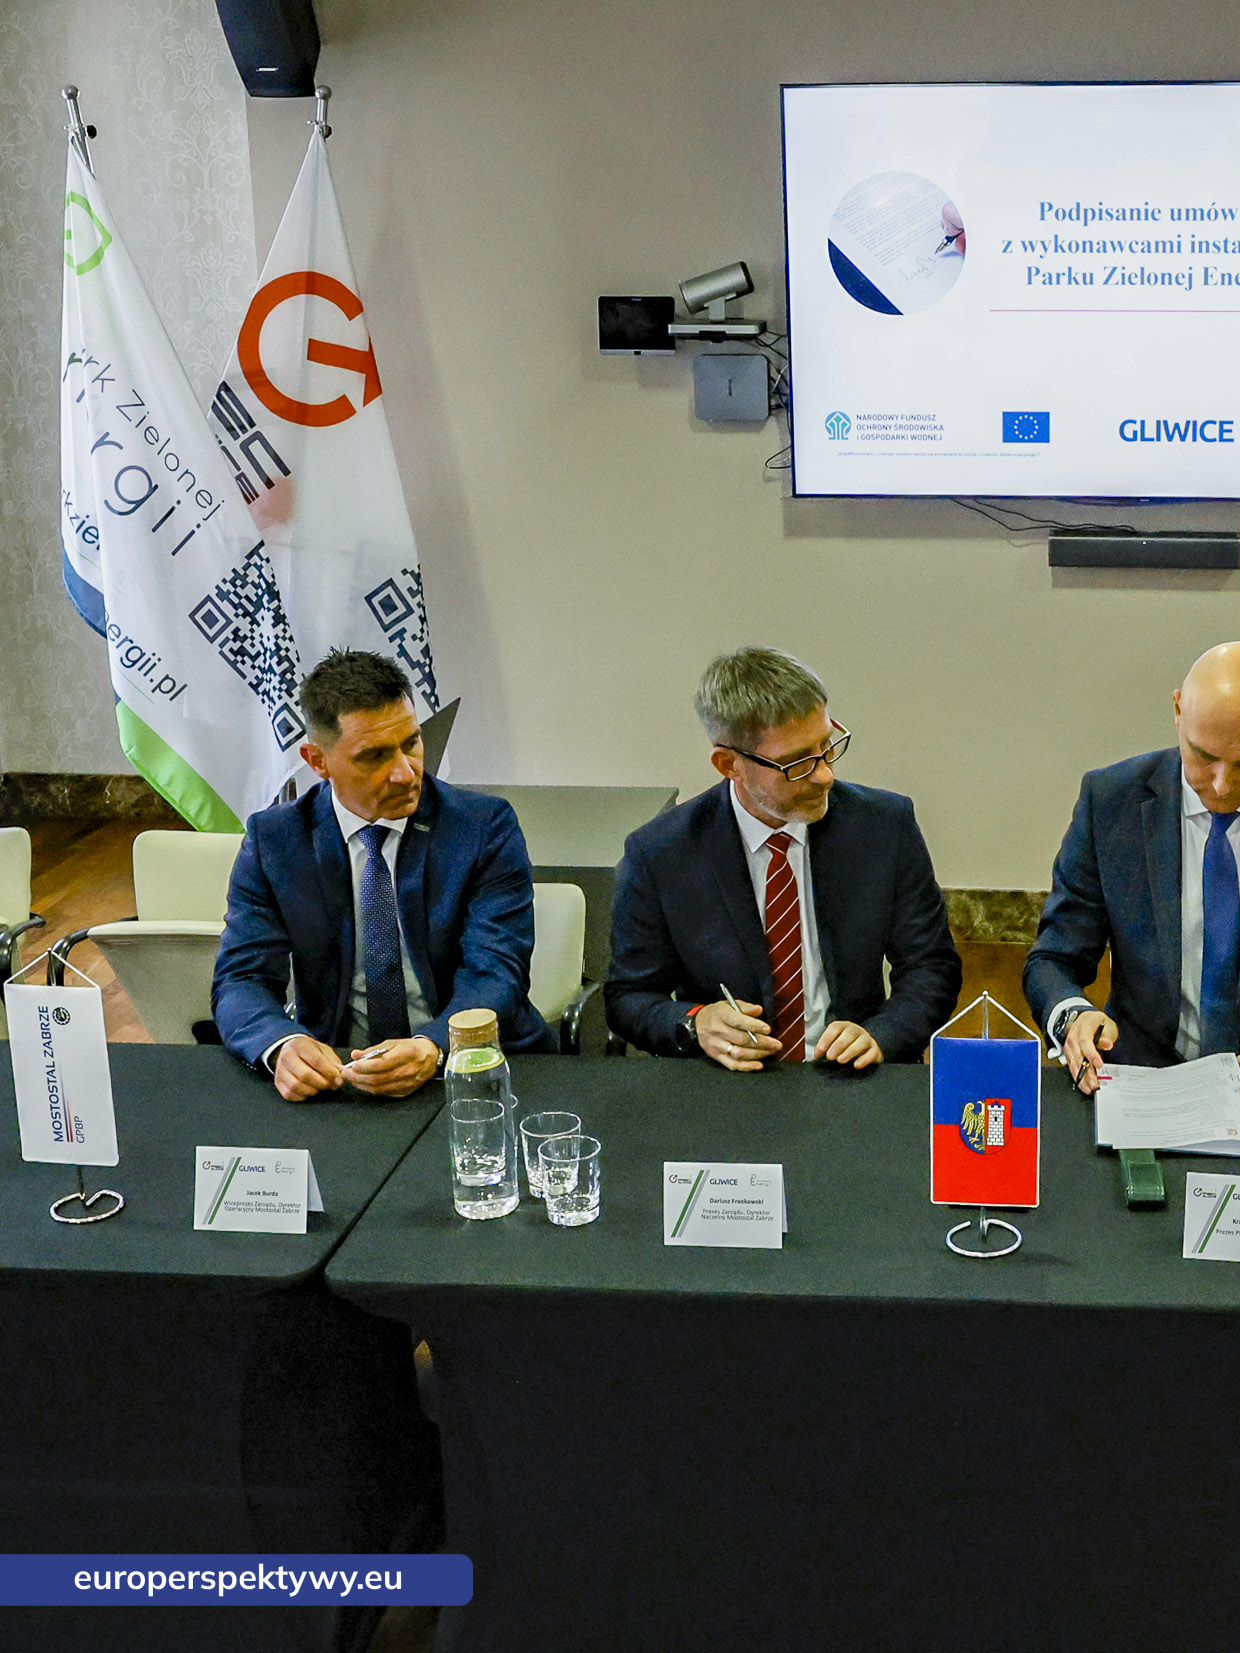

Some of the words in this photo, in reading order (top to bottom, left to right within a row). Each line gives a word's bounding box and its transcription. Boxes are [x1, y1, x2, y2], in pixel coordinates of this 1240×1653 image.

[1038, 202, 1162, 227] Podpisanie
[1169, 202, 1239, 221] umów
[1001, 239, 1013, 254] z
[1020, 234, 1182, 259] wykonawcami
[1026, 266, 1095, 286] Parku
[1102, 266, 1193, 291] Zielonej
[856, 414, 899, 422] NARODOWY
[901, 414, 937, 422] FUNDUSZ
[856, 424, 893, 432] OCHRONY
[894, 422, 945, 432] ŚRODOWISKA
[860, 433, 909, 442] GOSPODARKI
[910, 433, 943, 442] WODNEJ
[1118, 419, 1235, 443] GLIWICE
[115, 388, 225, 522] Zielonej
[38, 1005, 56, 1058] ZABRZE
[46, 1061, 64, 1143] MOSTOSTAL
[239, 1165, 266, 1173] GLIWICE
[709, 1178, 739, 1186] GLIWICE
